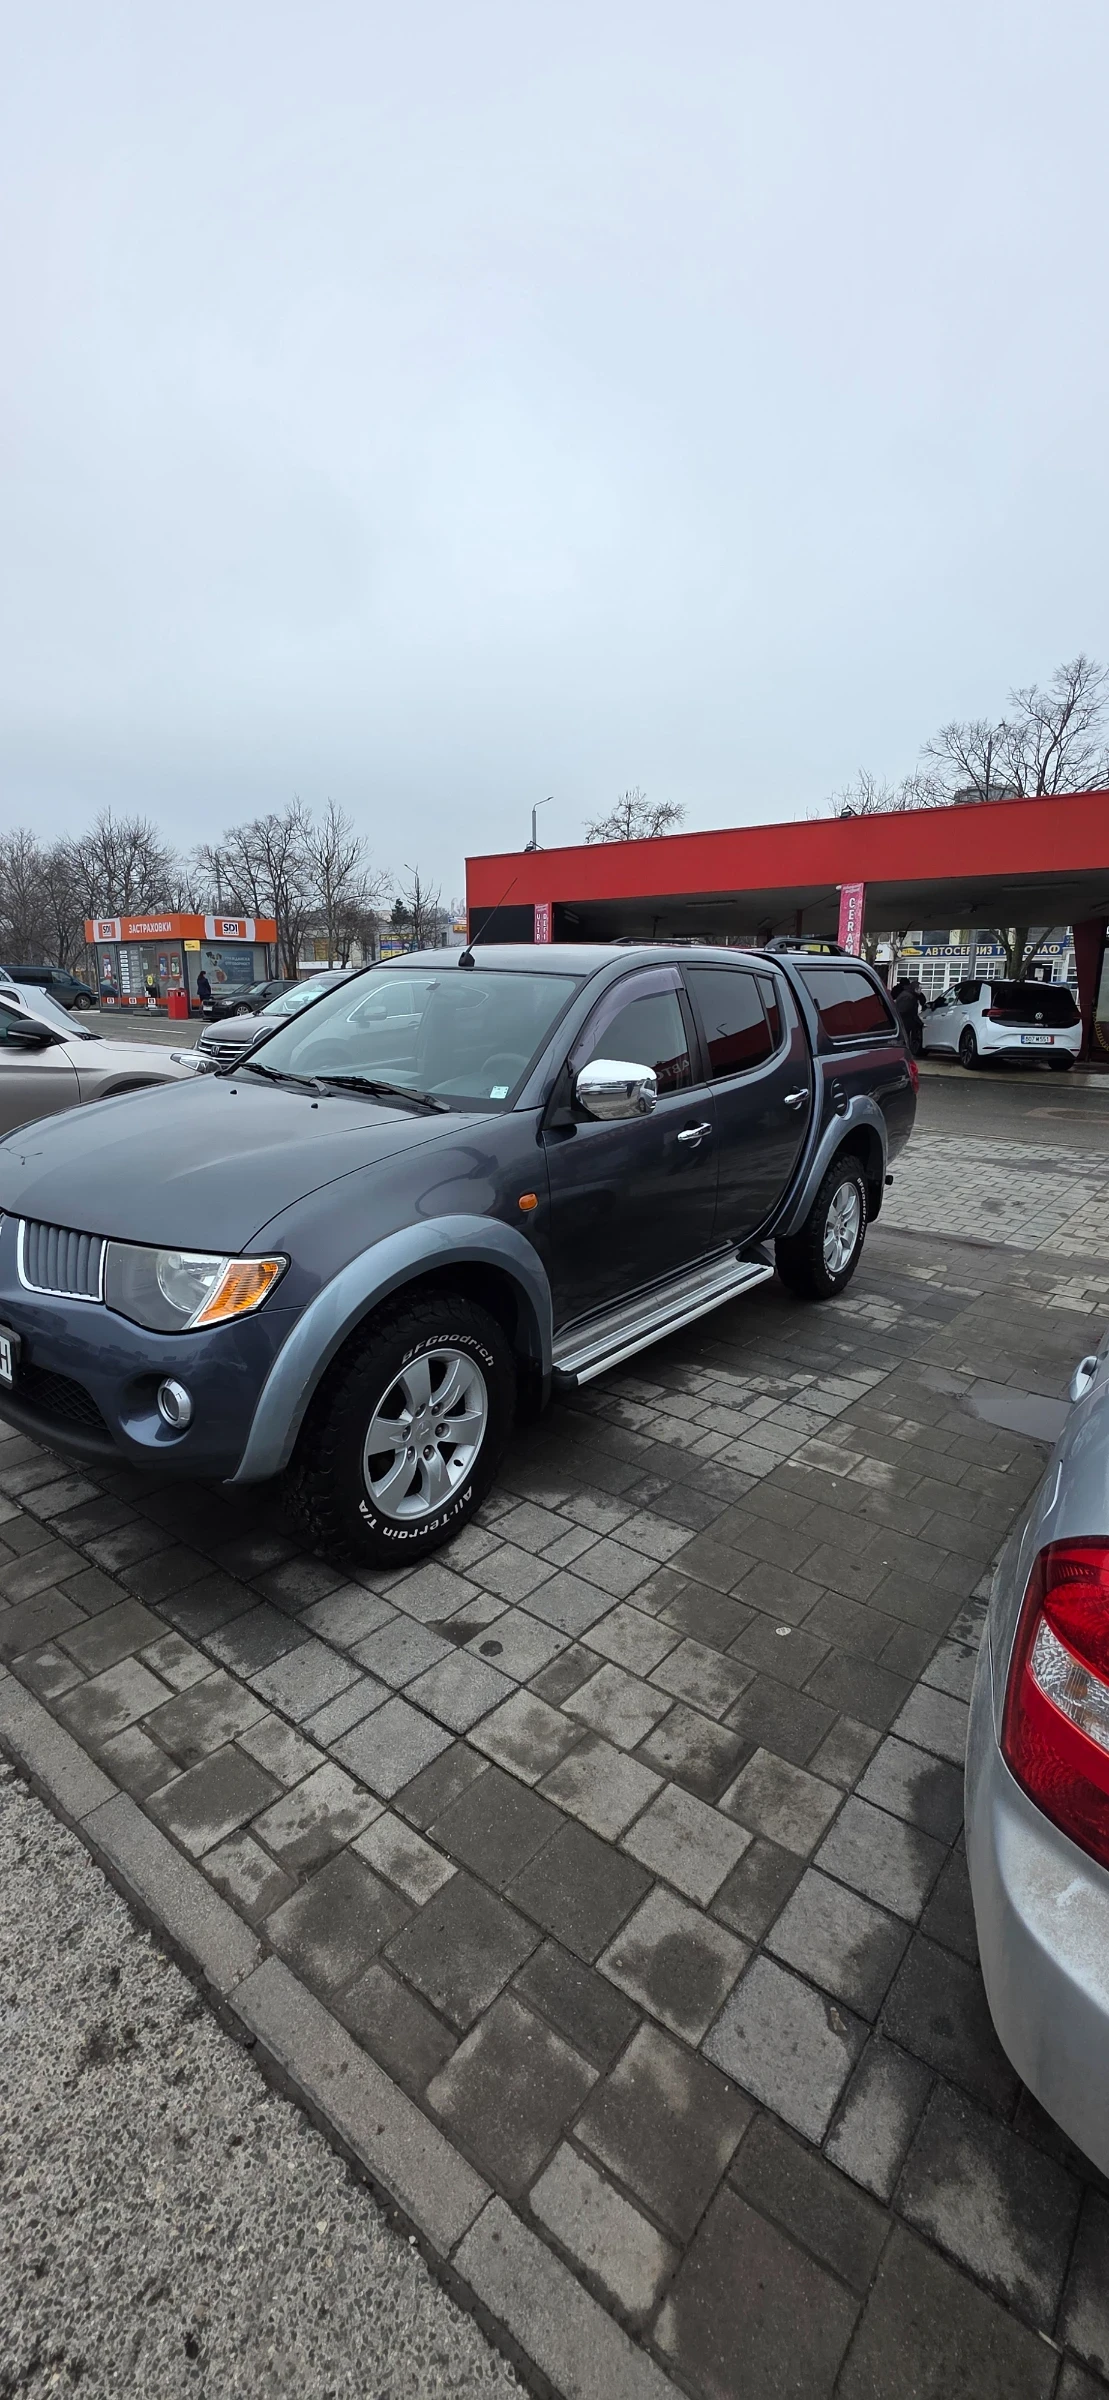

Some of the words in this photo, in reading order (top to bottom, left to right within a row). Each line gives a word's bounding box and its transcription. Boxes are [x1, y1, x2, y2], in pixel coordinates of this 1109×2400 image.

[102, 925, 111, 934] SDI
[128, 921, 172, 934] ЗАСТРАХОВКИ
[223, 923, 238, 932] SDI
[845, 897, 856, 955] CERAM
[401, 1333, 494, 1367] BFGoodrich
[358, 1499, 378, 1529] T/A
[382, 1485, 472, 1540] All-Terrain
